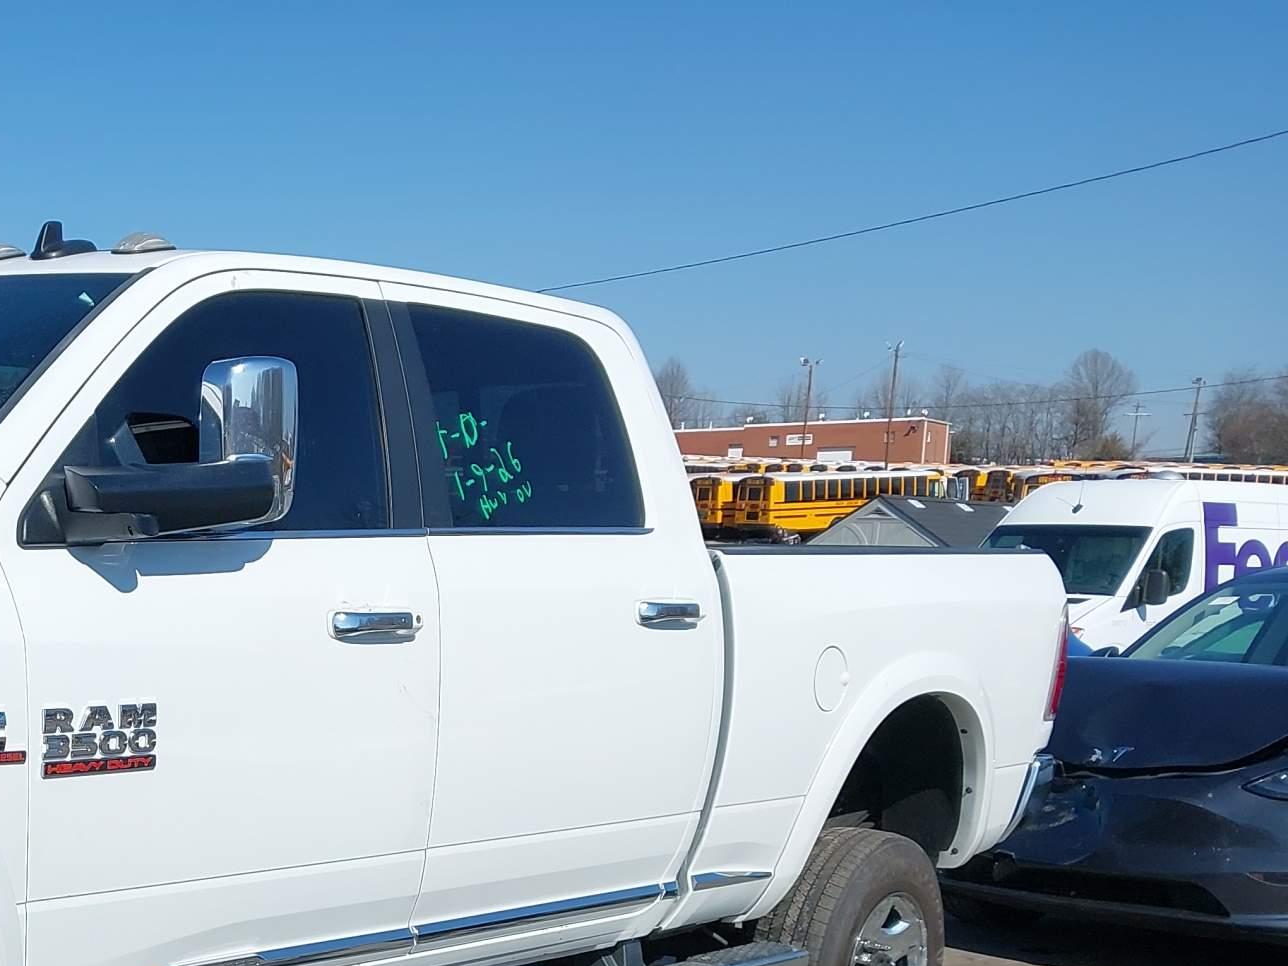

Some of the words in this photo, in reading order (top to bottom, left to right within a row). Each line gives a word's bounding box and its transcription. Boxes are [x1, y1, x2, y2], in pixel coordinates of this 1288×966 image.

[42, 703, 157, 734] RAM
[42, 729, 157, 760] 3500
[47, 760, 105, 775] HEAVY
[106, 756, 153, 770] DUTY
